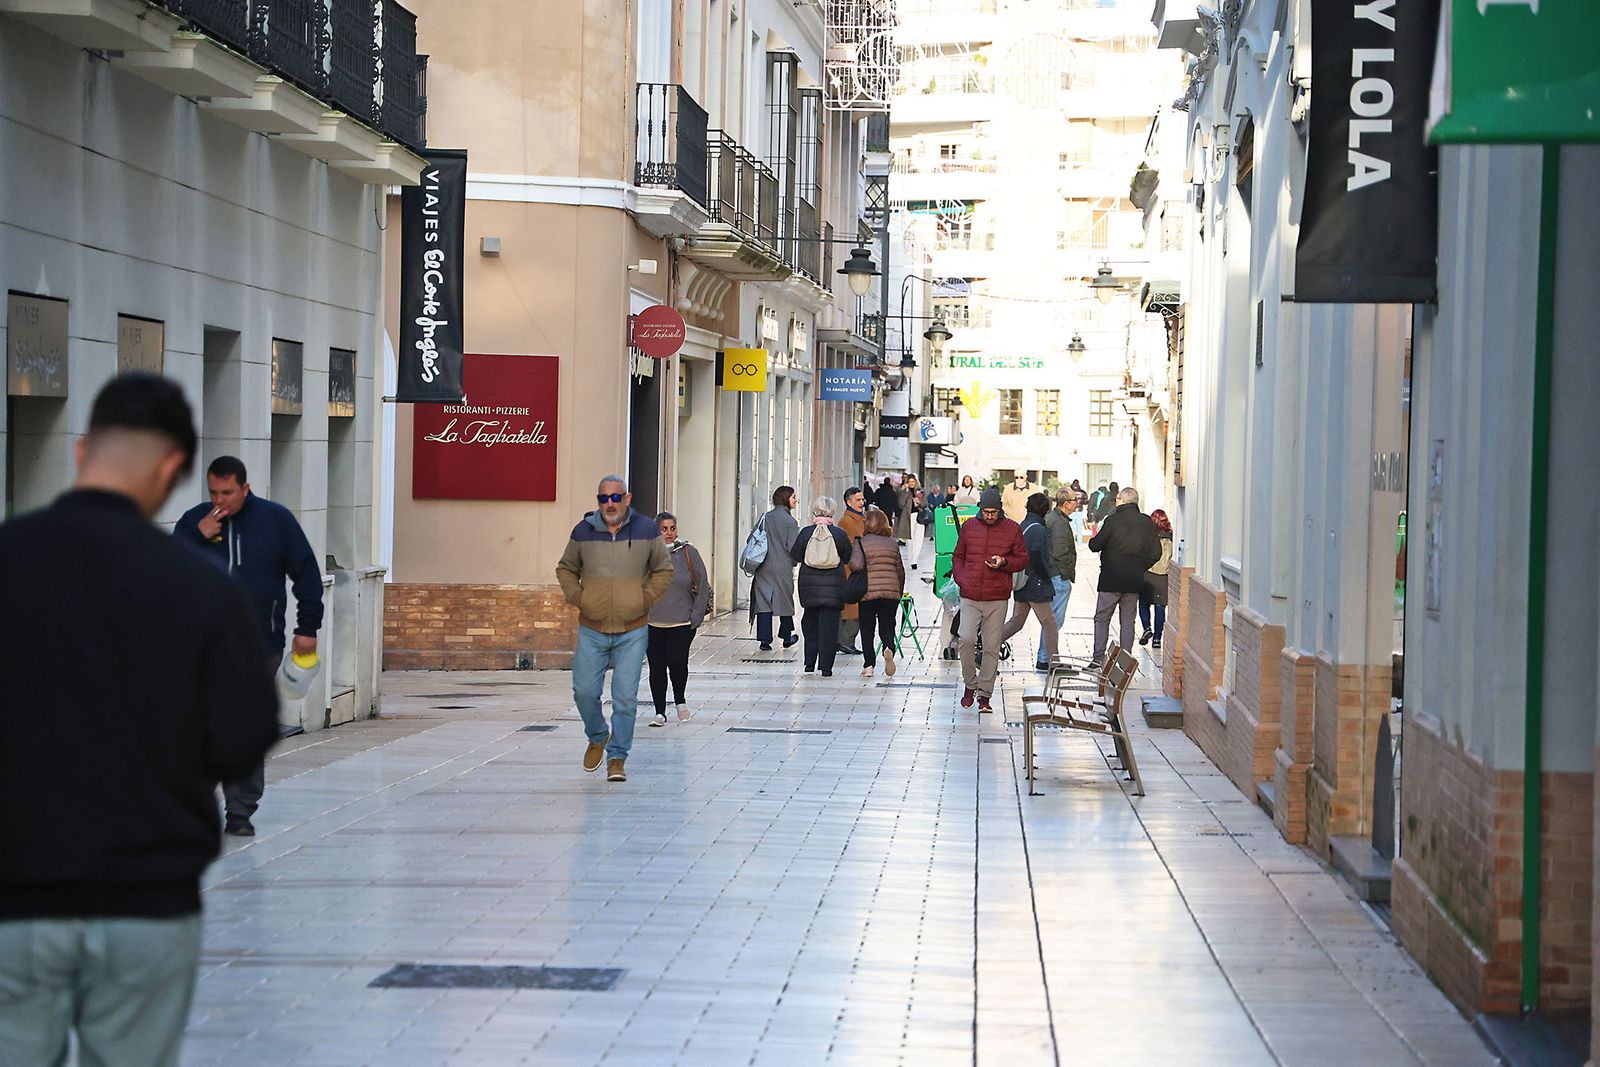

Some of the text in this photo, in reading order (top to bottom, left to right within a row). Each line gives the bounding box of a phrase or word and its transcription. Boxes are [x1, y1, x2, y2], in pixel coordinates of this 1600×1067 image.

[1347, 0, 1396, 192] Y LOLA
[421, 169, 440, 243] VIAJES
[825, 377, 867, 385] NOTARÍA
[443, 405, 530, 416] RISTORANTI PIZZERIE
[424, 418, 548, 447] La Tagliatella
